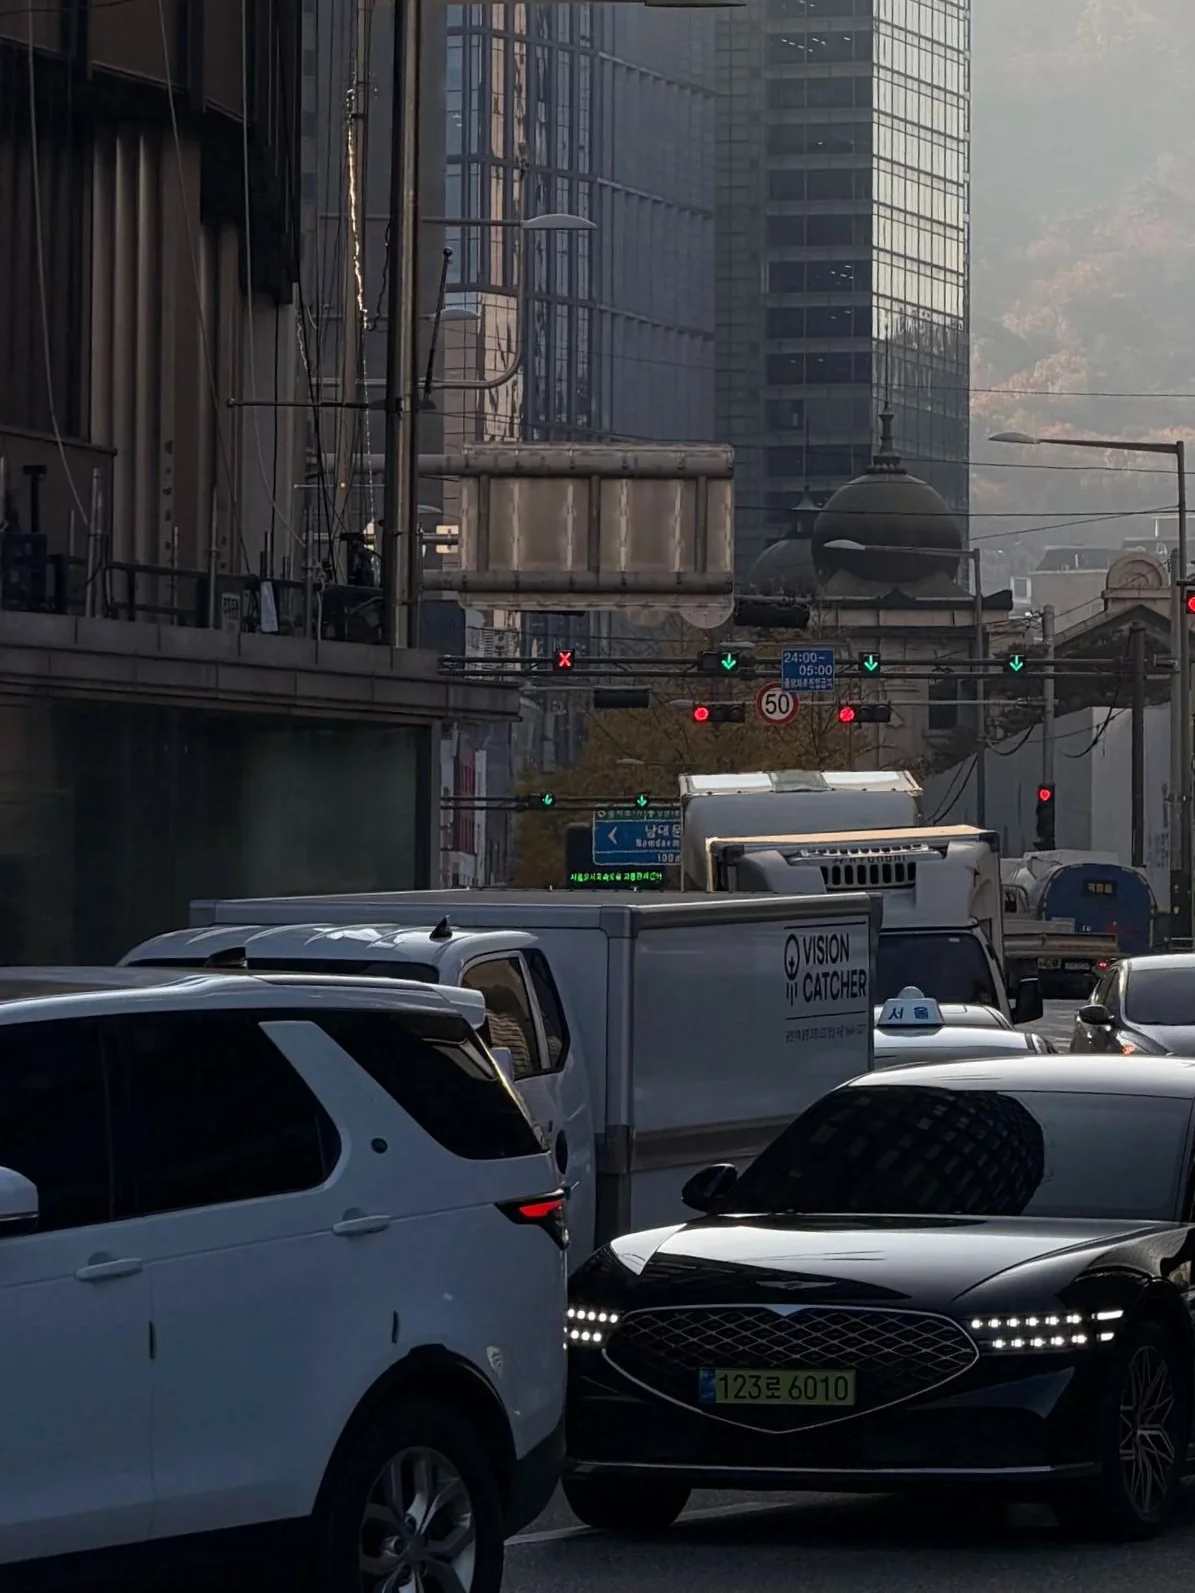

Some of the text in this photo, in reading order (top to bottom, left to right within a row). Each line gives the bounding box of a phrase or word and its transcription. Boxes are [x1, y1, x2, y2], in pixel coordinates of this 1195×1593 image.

[799, 664, 832, 676] 05:00
[765, 693, 790, 715] 50
[802, 932, 850, 965] VISION
[802, 969, 867, 1003] CATCHER
[719, 1374, 781, 1400] 123로
[788, 1375, 848, 1401] 6010
